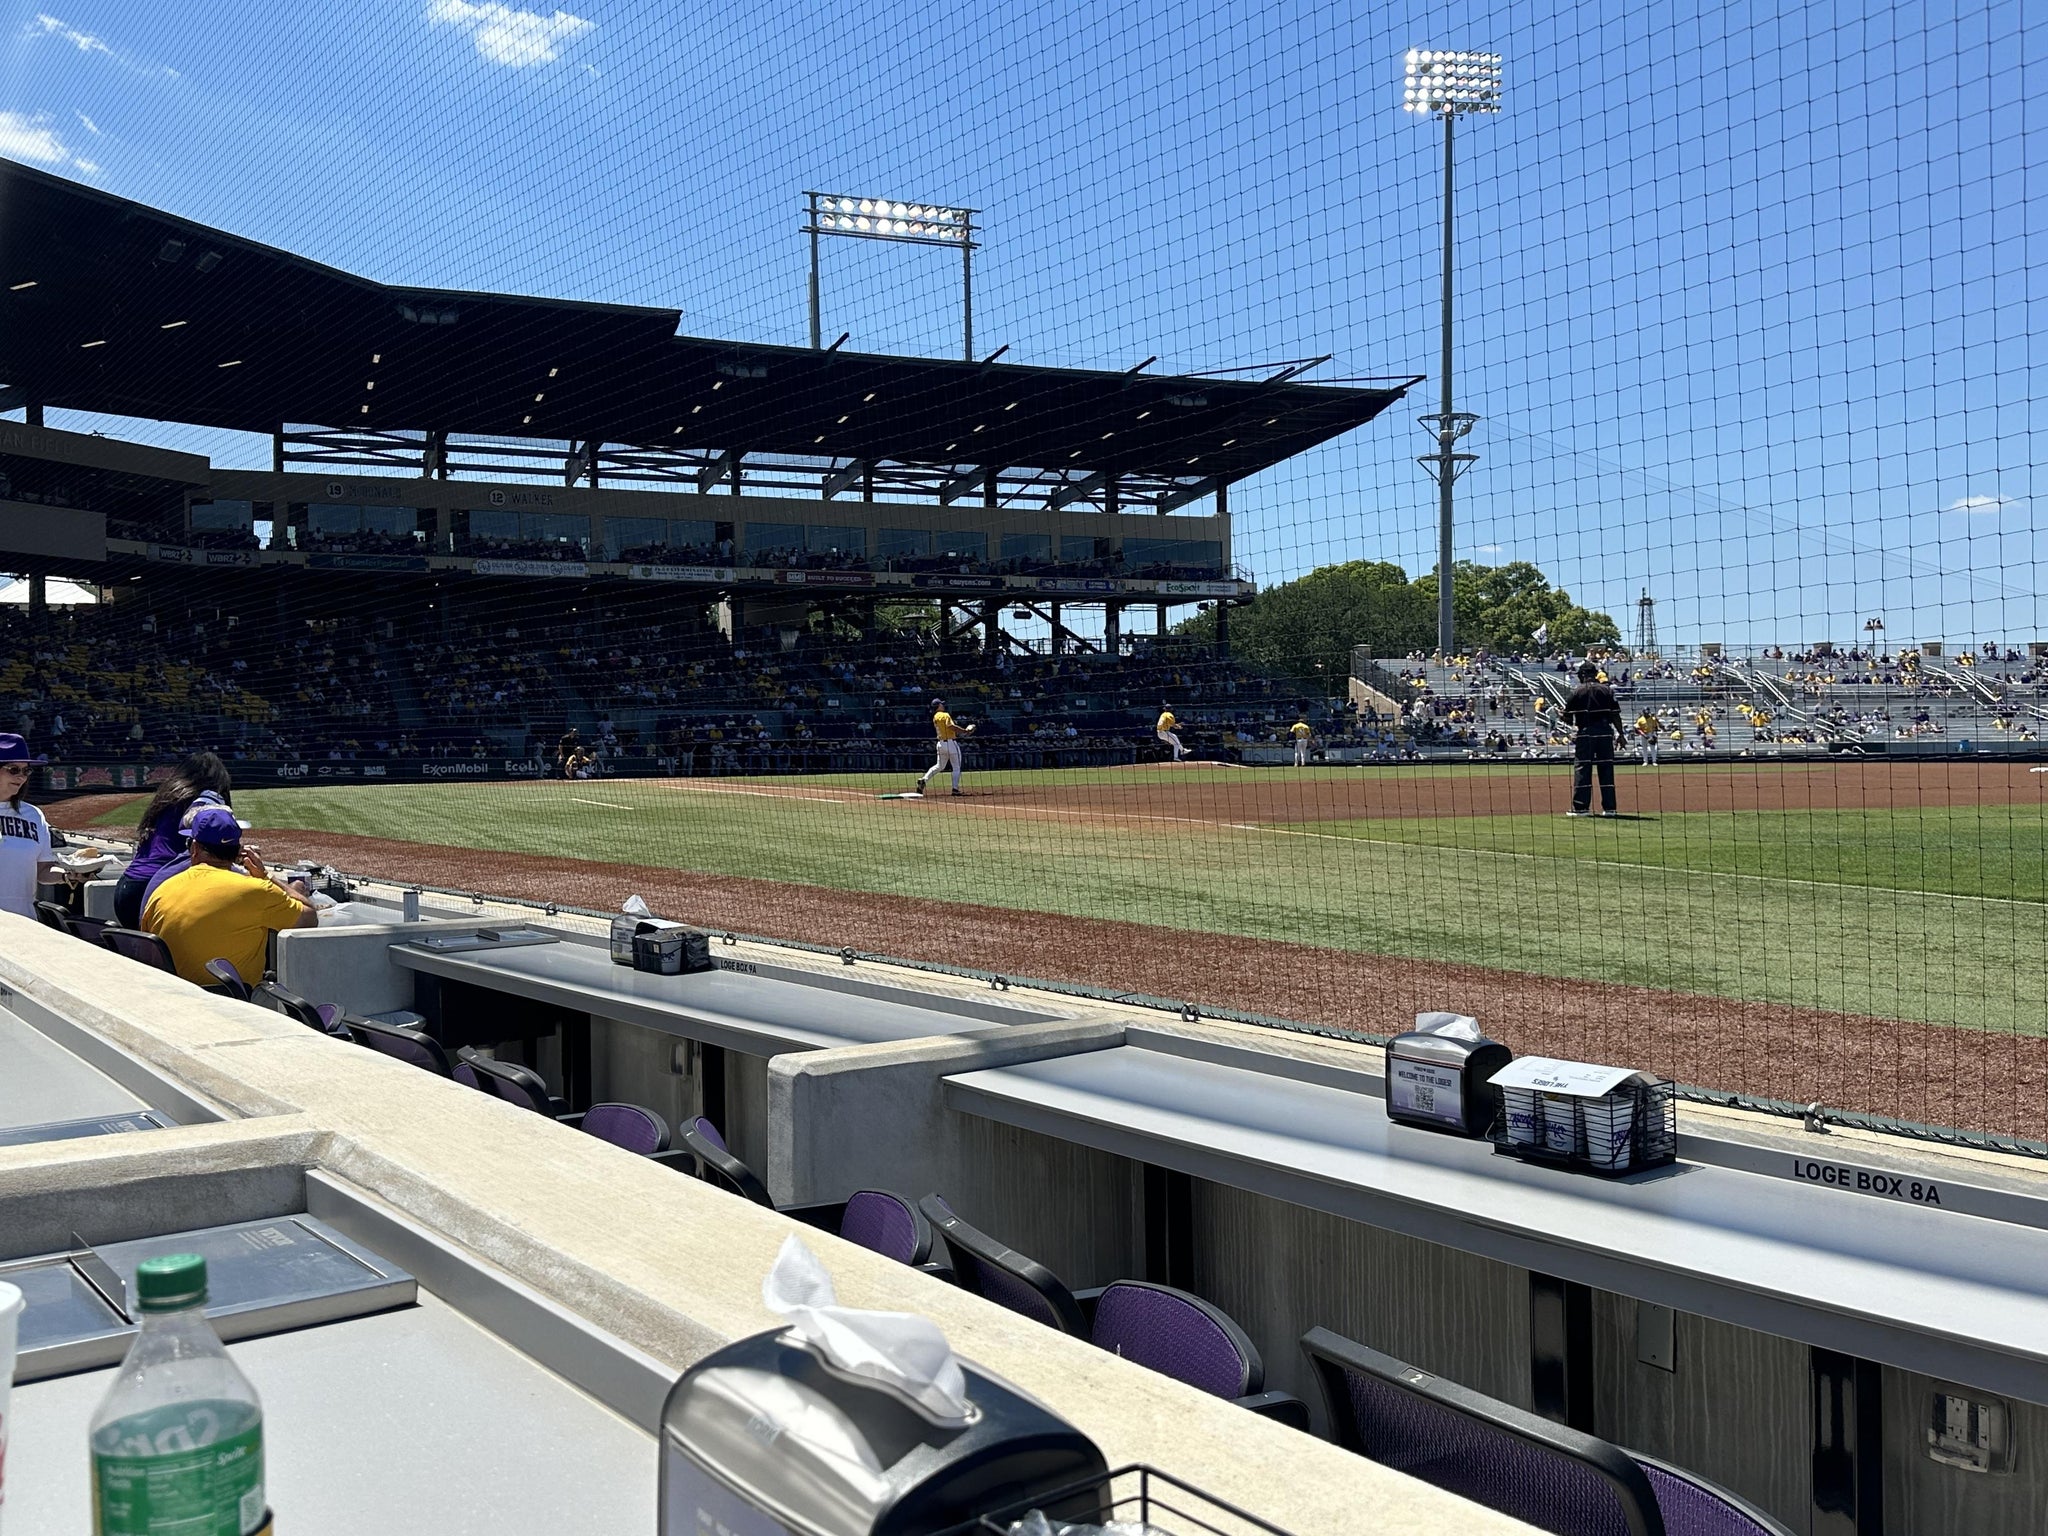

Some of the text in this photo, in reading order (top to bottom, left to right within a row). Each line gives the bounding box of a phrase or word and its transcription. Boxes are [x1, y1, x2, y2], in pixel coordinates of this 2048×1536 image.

[329, 485, 342, 496] 19
[492, 493, 553, 505] 12 WALKER
[277, 763, 301, 776] efcu
[422, 763, 489, 776] ExxonMobil
[505, 760, 552, 772] EcoLie
[0, 815, 40, 844] IGERS
[720, 959, 757, 974] LOGE BOX 9A
[1398, 1070, 1418, 1081] WELCOME
[1794, 1160, 1941, 1204] LOGE BOX 8A
[1409, 1374, 1423, 1384] 2
[216, 1446, 248, 1467] Sprite
